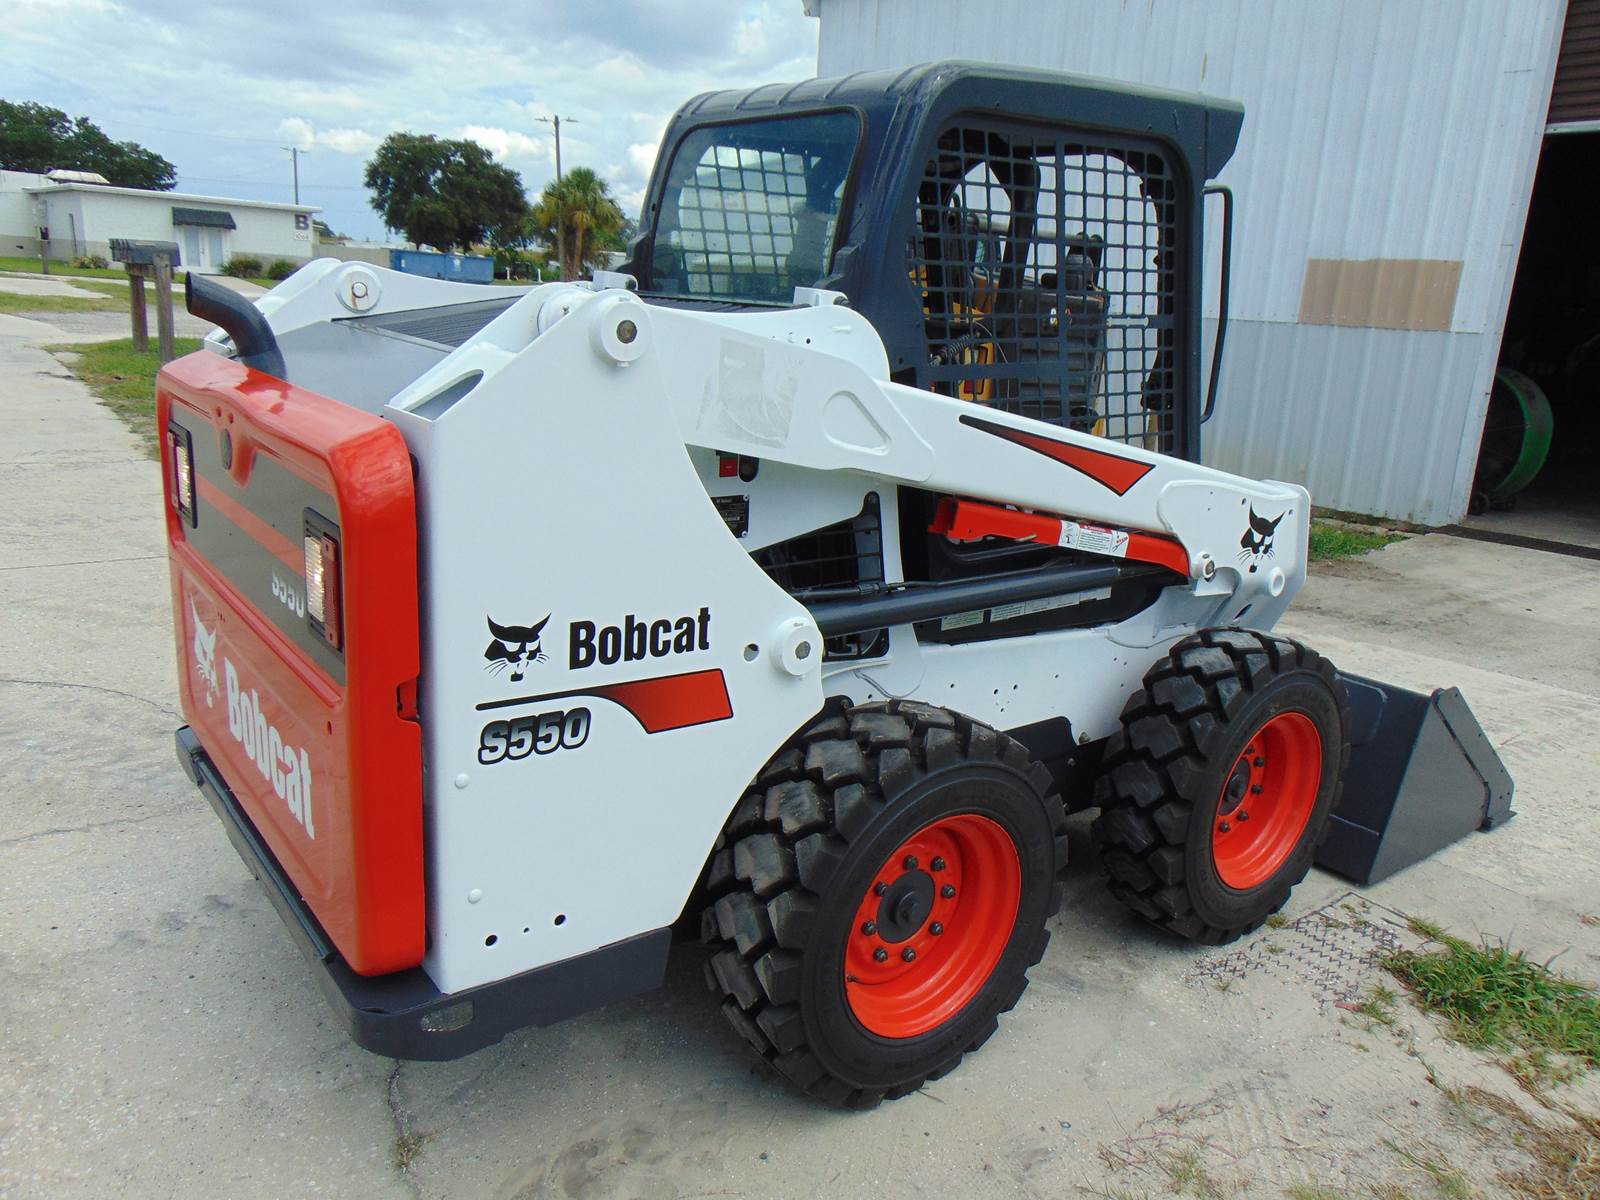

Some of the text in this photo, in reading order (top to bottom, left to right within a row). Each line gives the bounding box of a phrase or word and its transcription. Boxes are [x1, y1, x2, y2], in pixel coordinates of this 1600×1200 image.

[295, 214, 309, 230] B
[569, 606, 711, 670] Bobcat
[224, 656, 315, 840] Bobcat
[478, 707, 591, 765] S550
